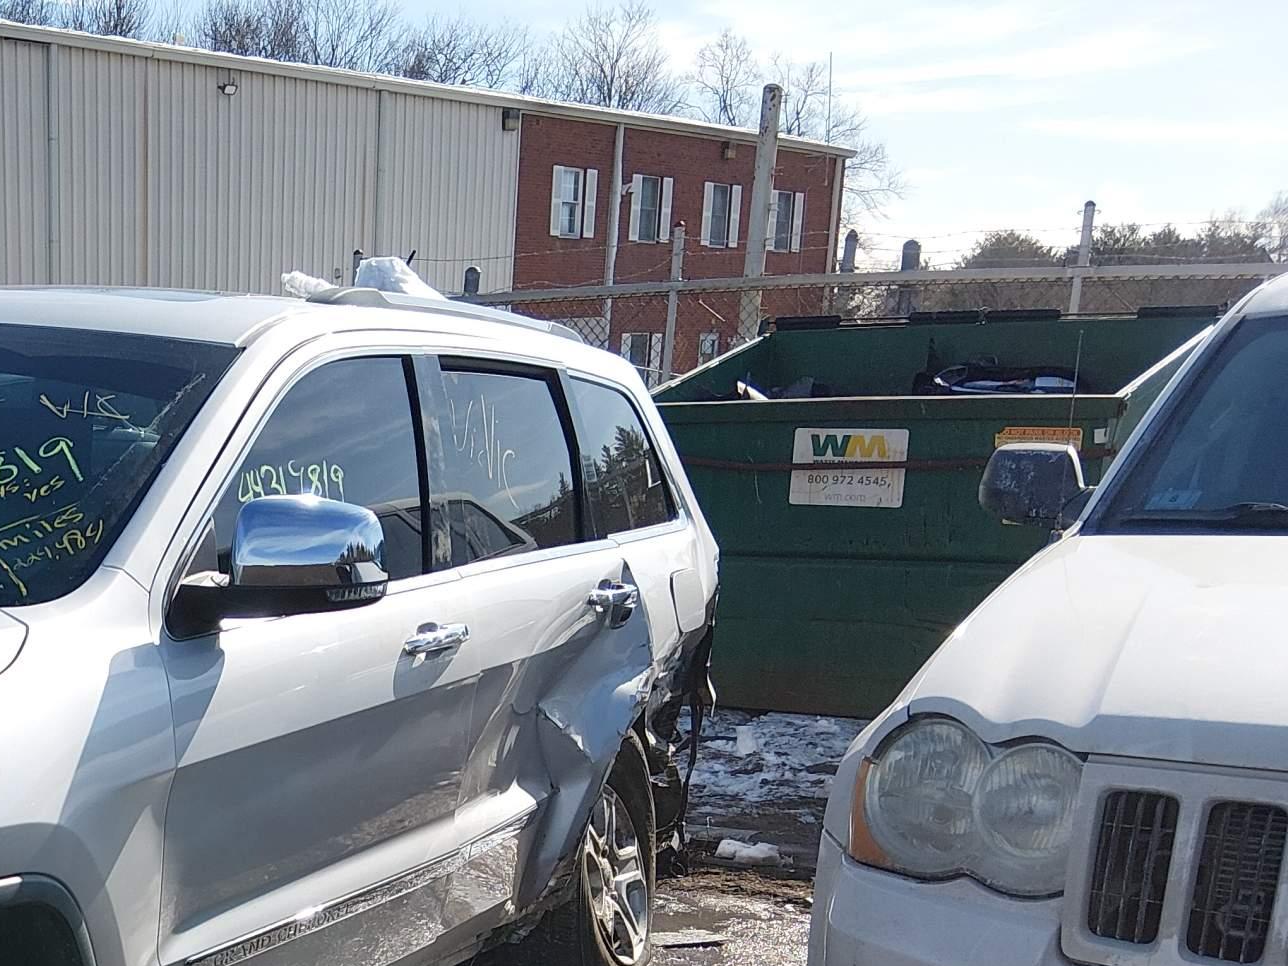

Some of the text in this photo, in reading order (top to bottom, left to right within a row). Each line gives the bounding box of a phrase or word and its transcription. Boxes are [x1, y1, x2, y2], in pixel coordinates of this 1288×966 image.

[811, 434, 888, 458] WM
[807, 474, 829, 484] 800
[832, 476, 853, 485] 972
